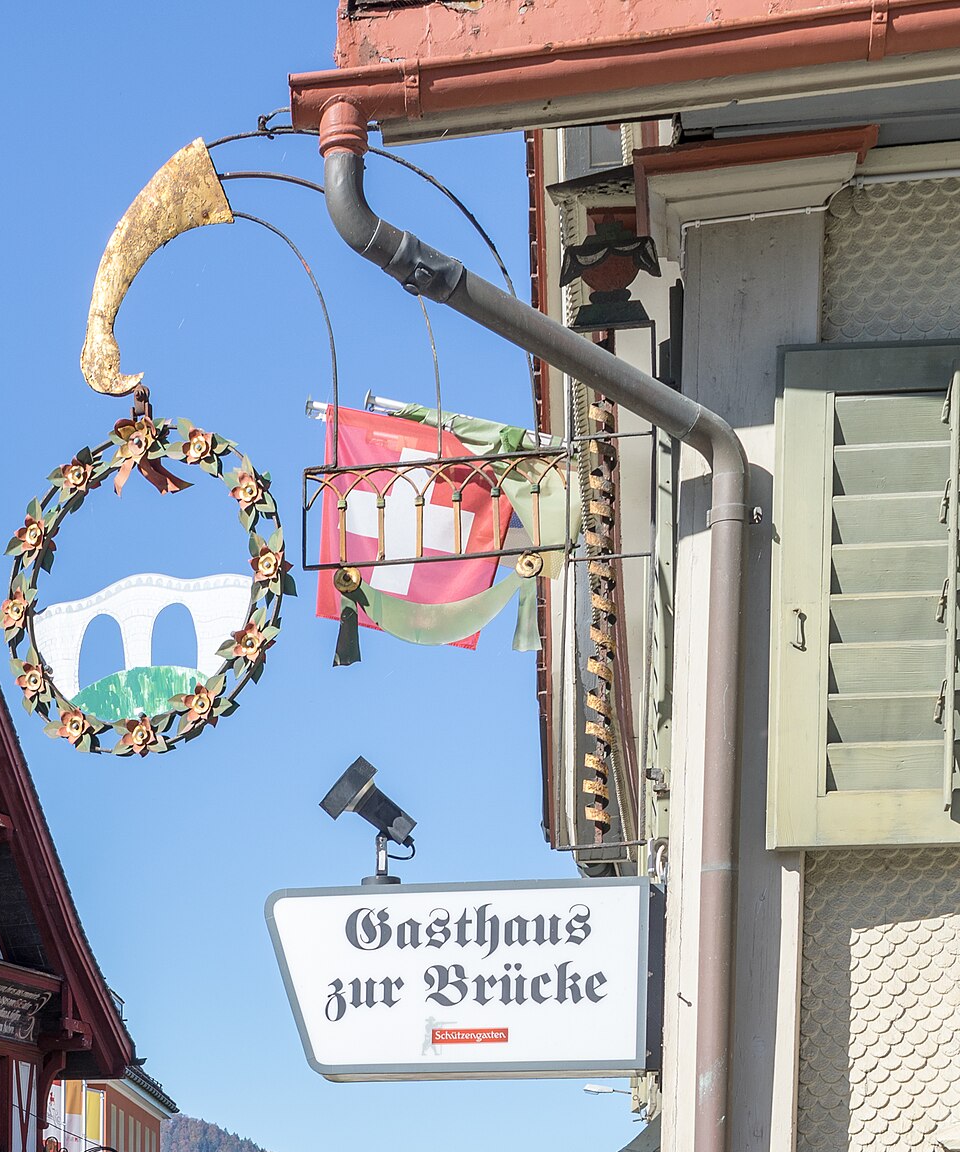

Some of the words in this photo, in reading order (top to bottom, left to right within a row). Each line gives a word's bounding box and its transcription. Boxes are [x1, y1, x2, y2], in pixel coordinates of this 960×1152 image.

[345, 903, 592, 959] Gasthaus
[325, 976, 405, 1022] zur
[424, 961, 608, 1006] Brücke
[434, 1029, 507, 1043] Schützengarten
